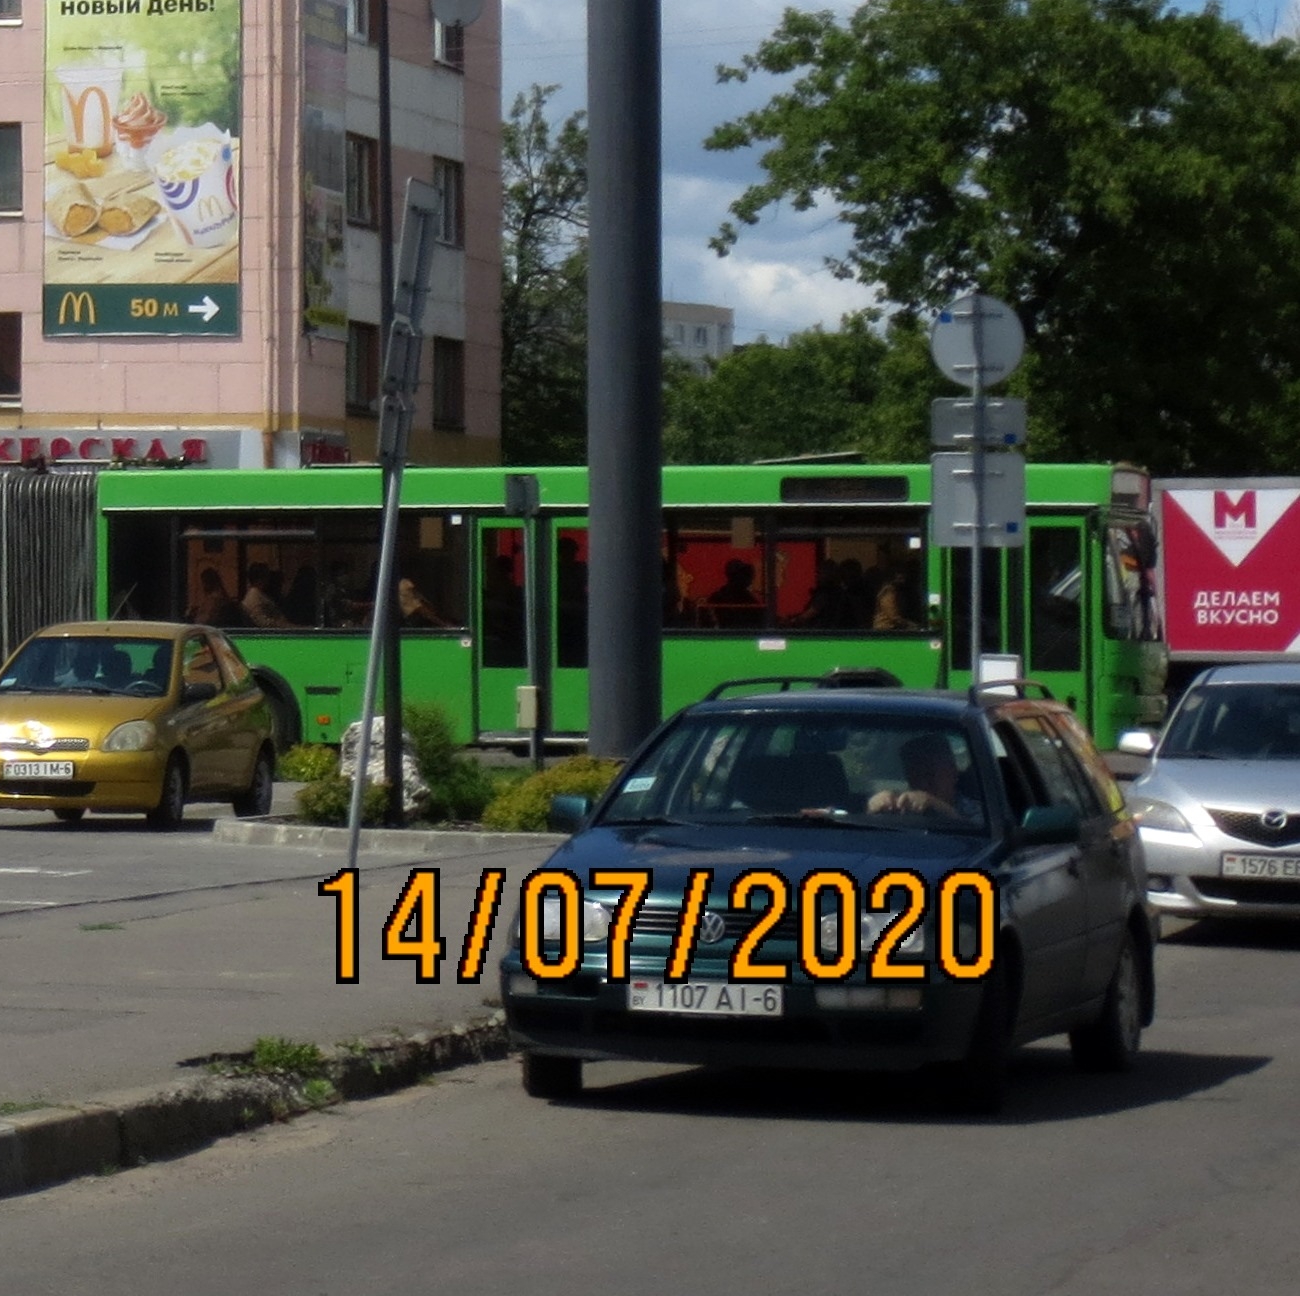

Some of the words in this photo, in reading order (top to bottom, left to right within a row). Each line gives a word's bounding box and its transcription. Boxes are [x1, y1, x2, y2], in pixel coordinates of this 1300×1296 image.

[130, 298, 159, 318] 50
[1194, 591, 1280, 609] ДЕЛАЕМ
[1197, 609, 1279, 625] ВКУСНО
[13, 764, 40, 775] 0313
[1241, 857, 1277, 875] 1576
[656, 983, 708, 1009] 1107
[715, 986, 777, 1012] AI-6
